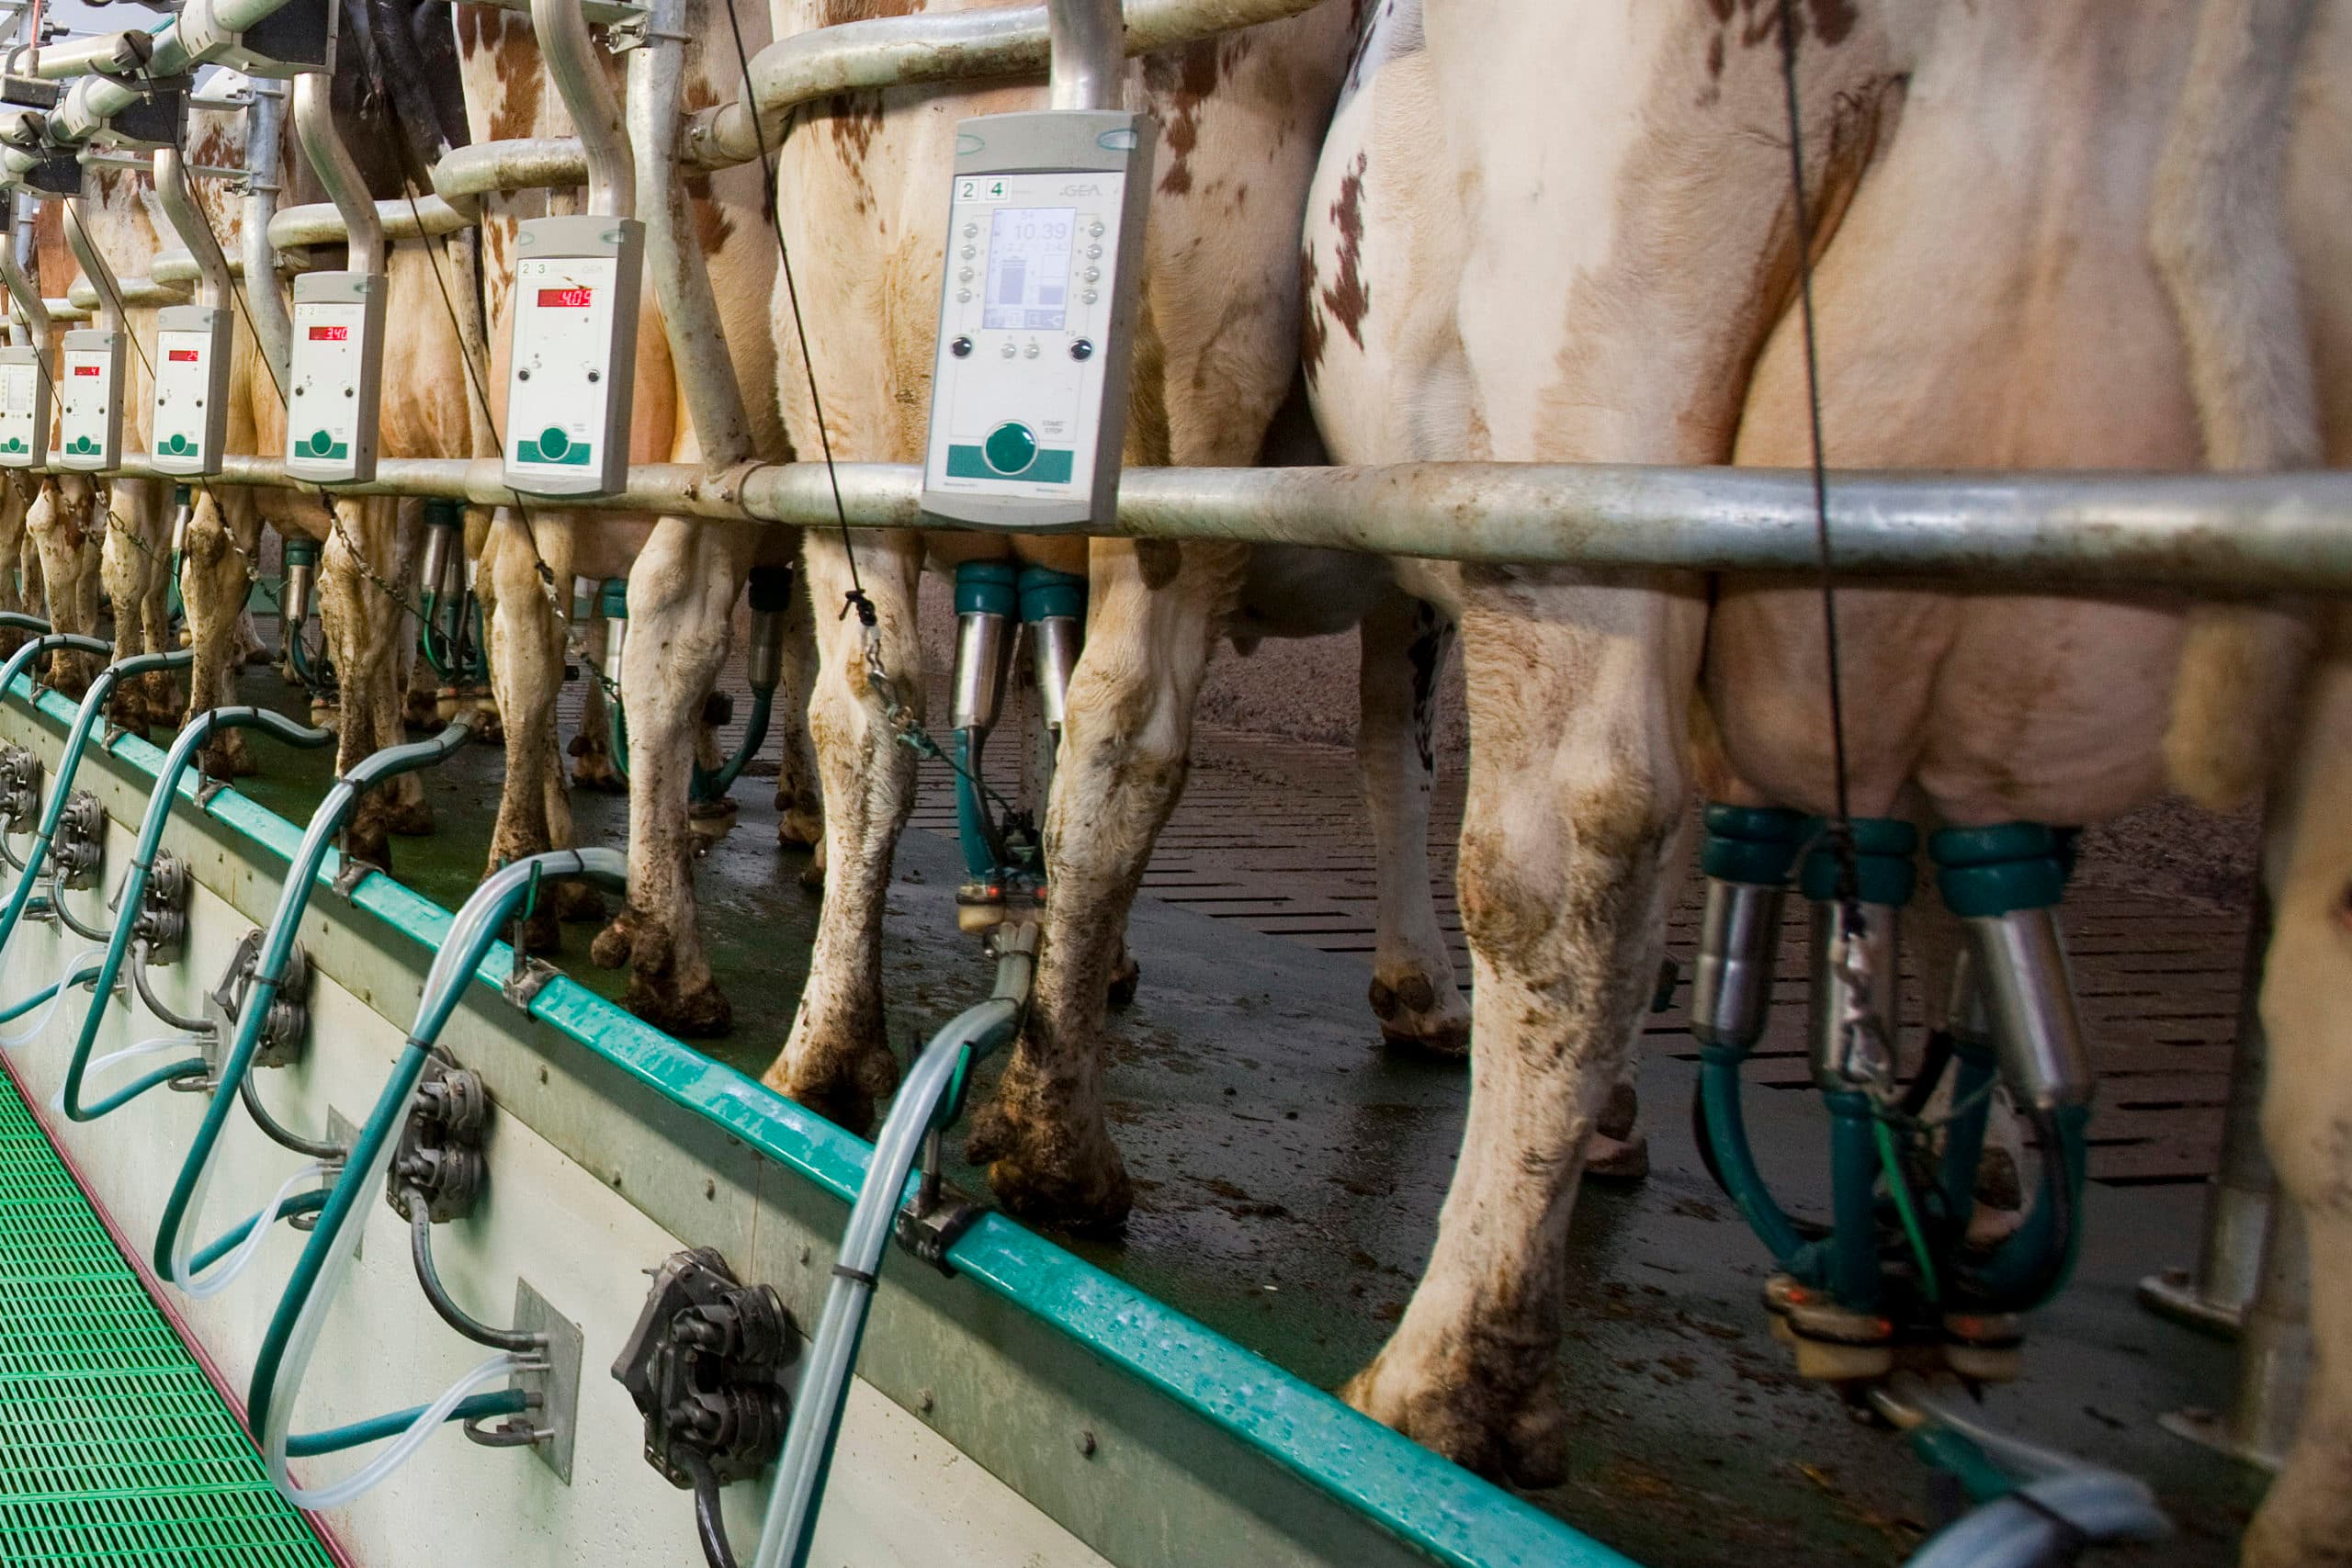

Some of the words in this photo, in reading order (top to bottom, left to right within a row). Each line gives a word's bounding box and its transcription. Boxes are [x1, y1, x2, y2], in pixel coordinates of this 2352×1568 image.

[963, 182, 974, 197] 2
[990, 181, 1003, 197] 4
[1063, 185, 1102, 197] GEA
[522, 263, 530, 274] 2
[537, 264, 546, 274] 3
